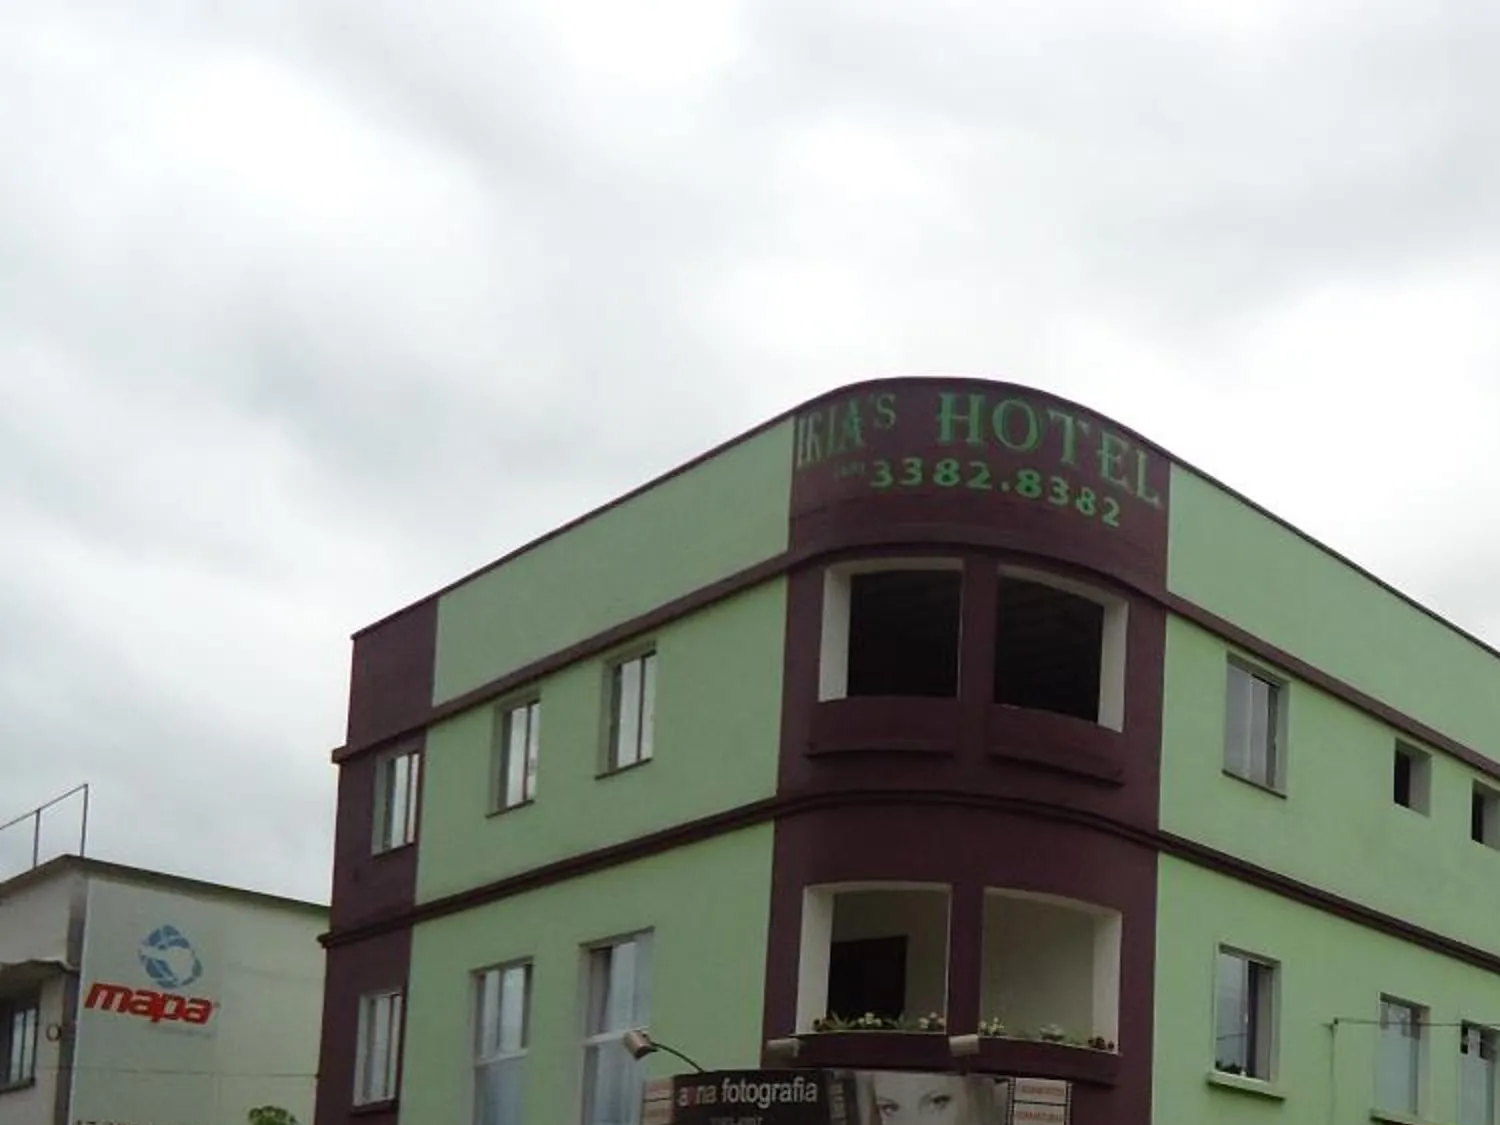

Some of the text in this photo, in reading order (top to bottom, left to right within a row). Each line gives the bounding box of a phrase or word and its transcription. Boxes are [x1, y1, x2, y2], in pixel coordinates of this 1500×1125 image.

[937, 391, 1163, 509] HOTEL
[869, 457, 1121, 528] 3382.8382
[84, 982, 215, 1025] mapa
[721, 1075, 818, 1109] fotografia
